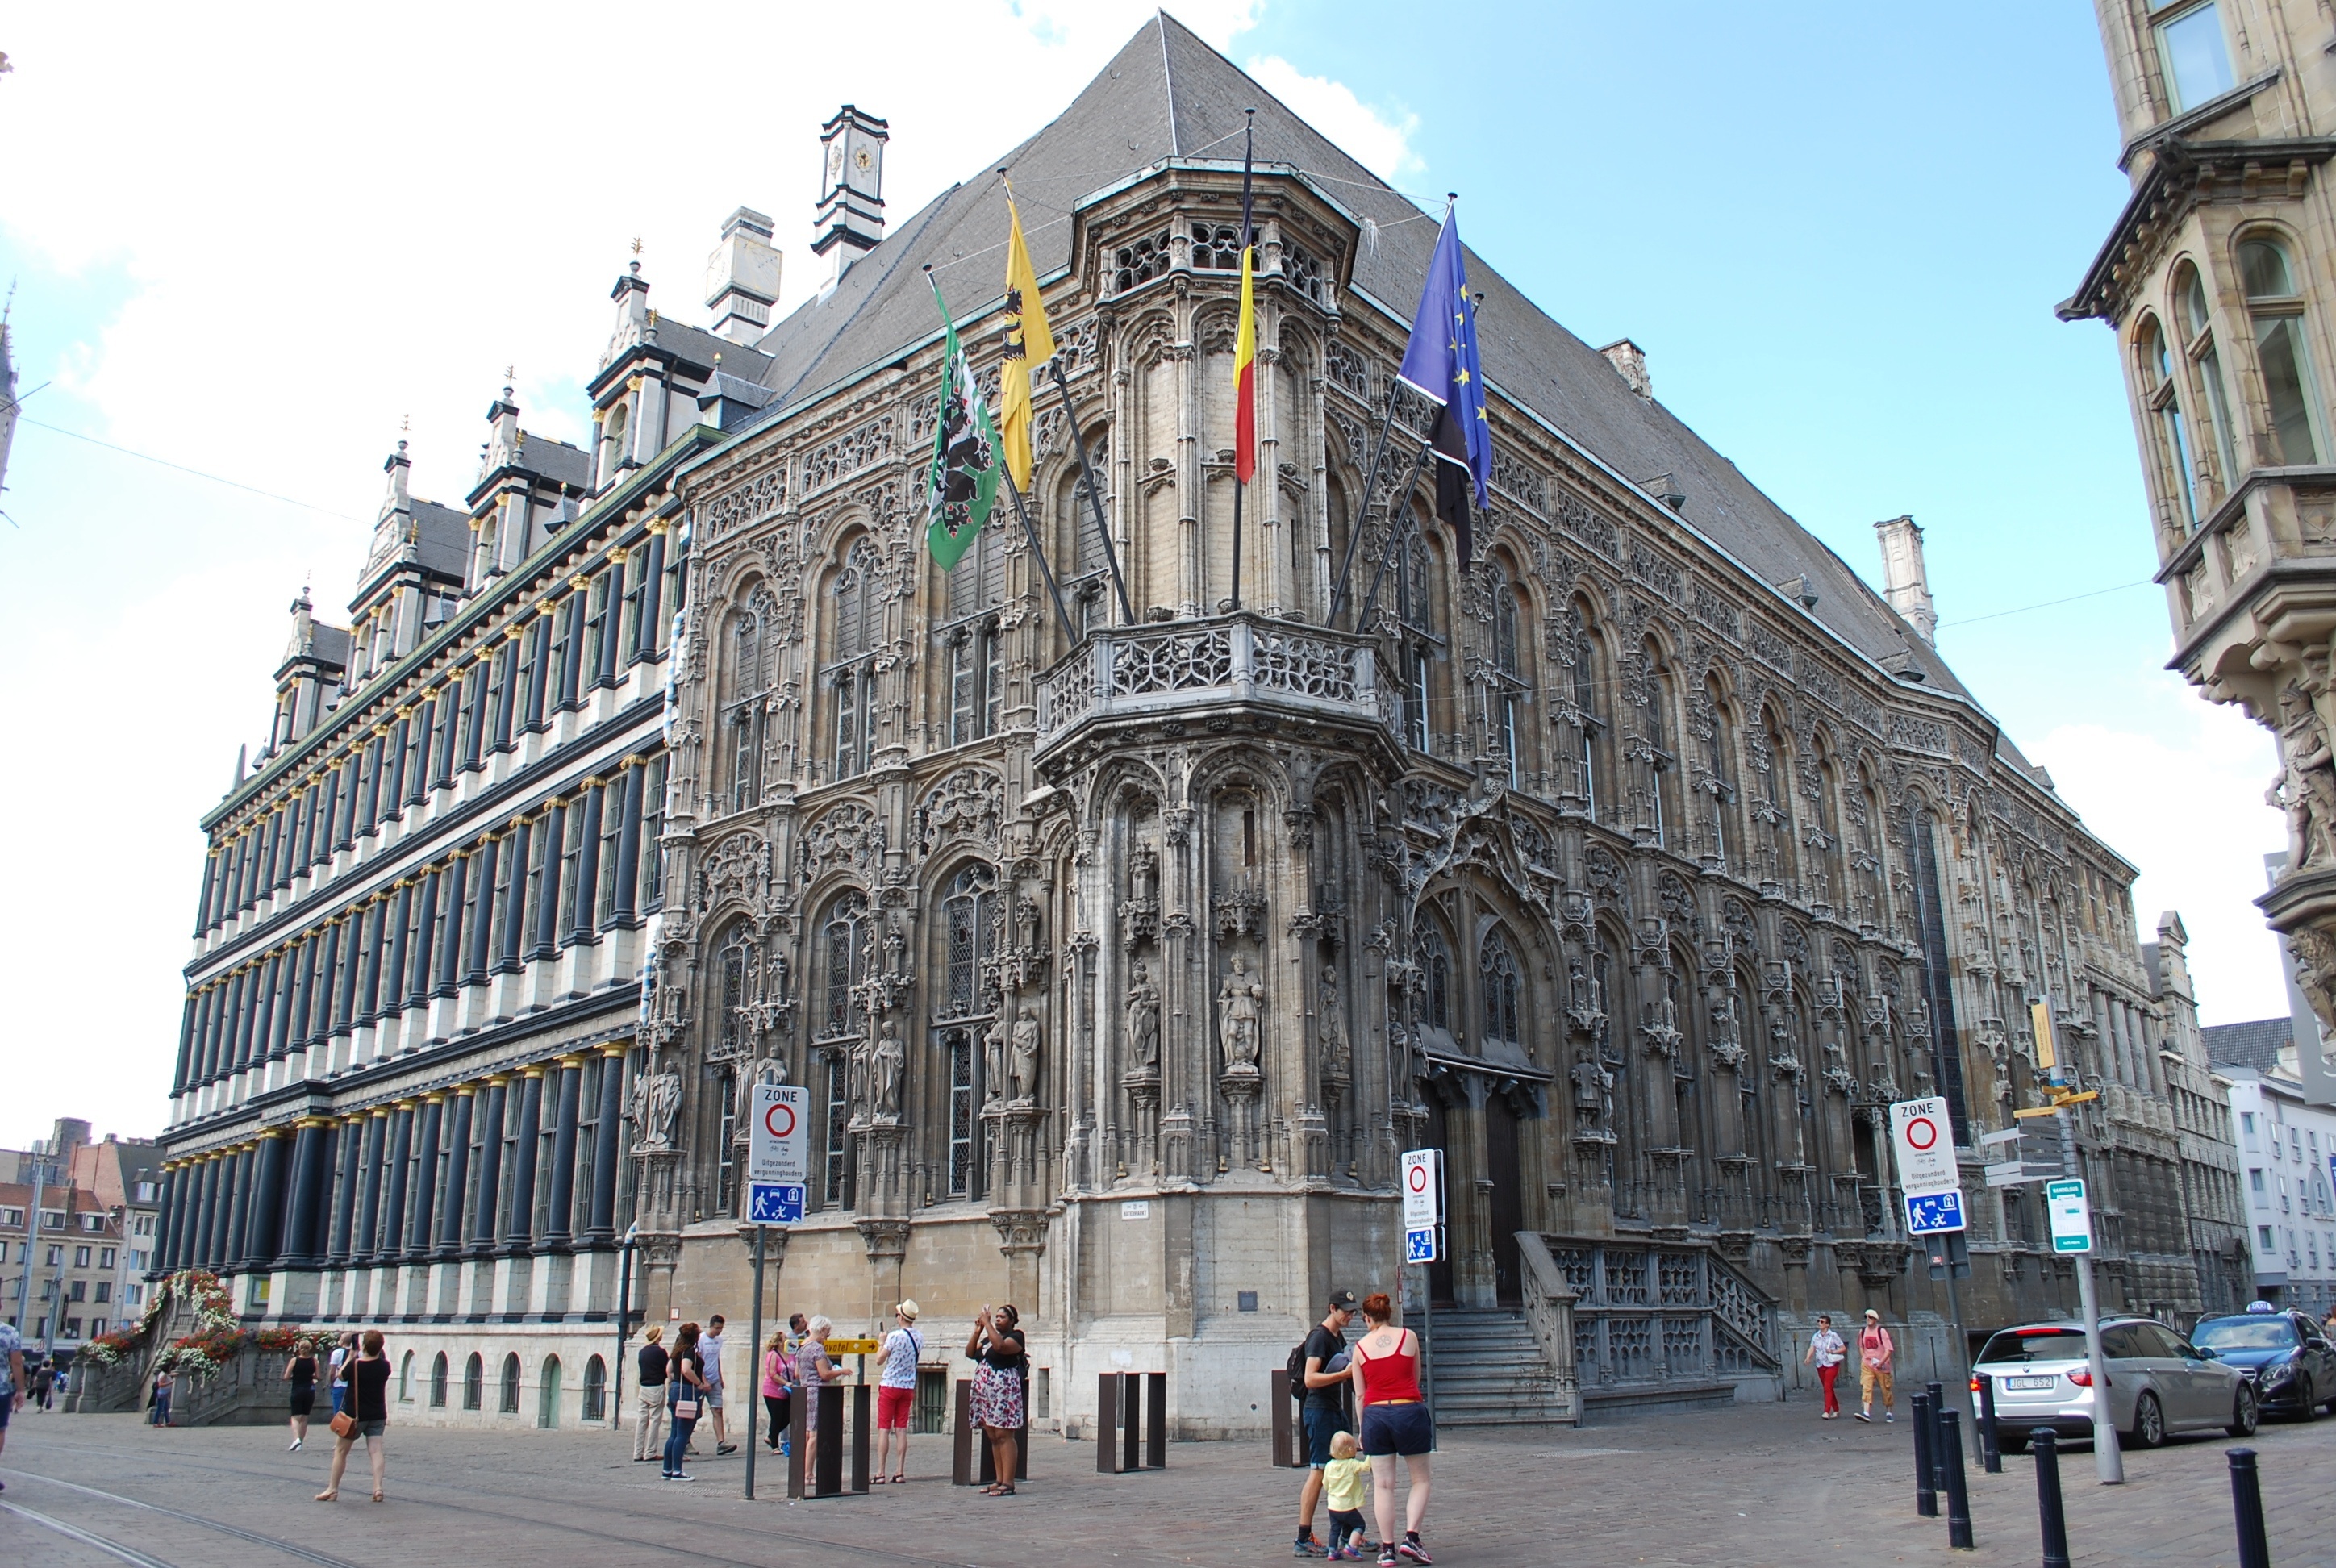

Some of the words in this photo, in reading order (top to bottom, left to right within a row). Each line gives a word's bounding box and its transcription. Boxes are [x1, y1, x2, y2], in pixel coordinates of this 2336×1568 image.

[765, 1089, 798, 1103] ZONE
[1901, 1103, 1934, 1117] ZONE
[761, 1159, 795, 1167] Uitgezonderd
[1408, 1153, 1426, 1165] ZONE
[754, 1168, 803, 1178] vergunninghouders
[1911, 1170, 1946, 1180] Uitgezonderd
[1905, 1178, 1955, 1191] vergunninghouders
[823, 1342, 849, 1352] ovotel
[2012, 1378, 2027, 1387] JGL
[2033, 1378, 2050, 1387] 652
